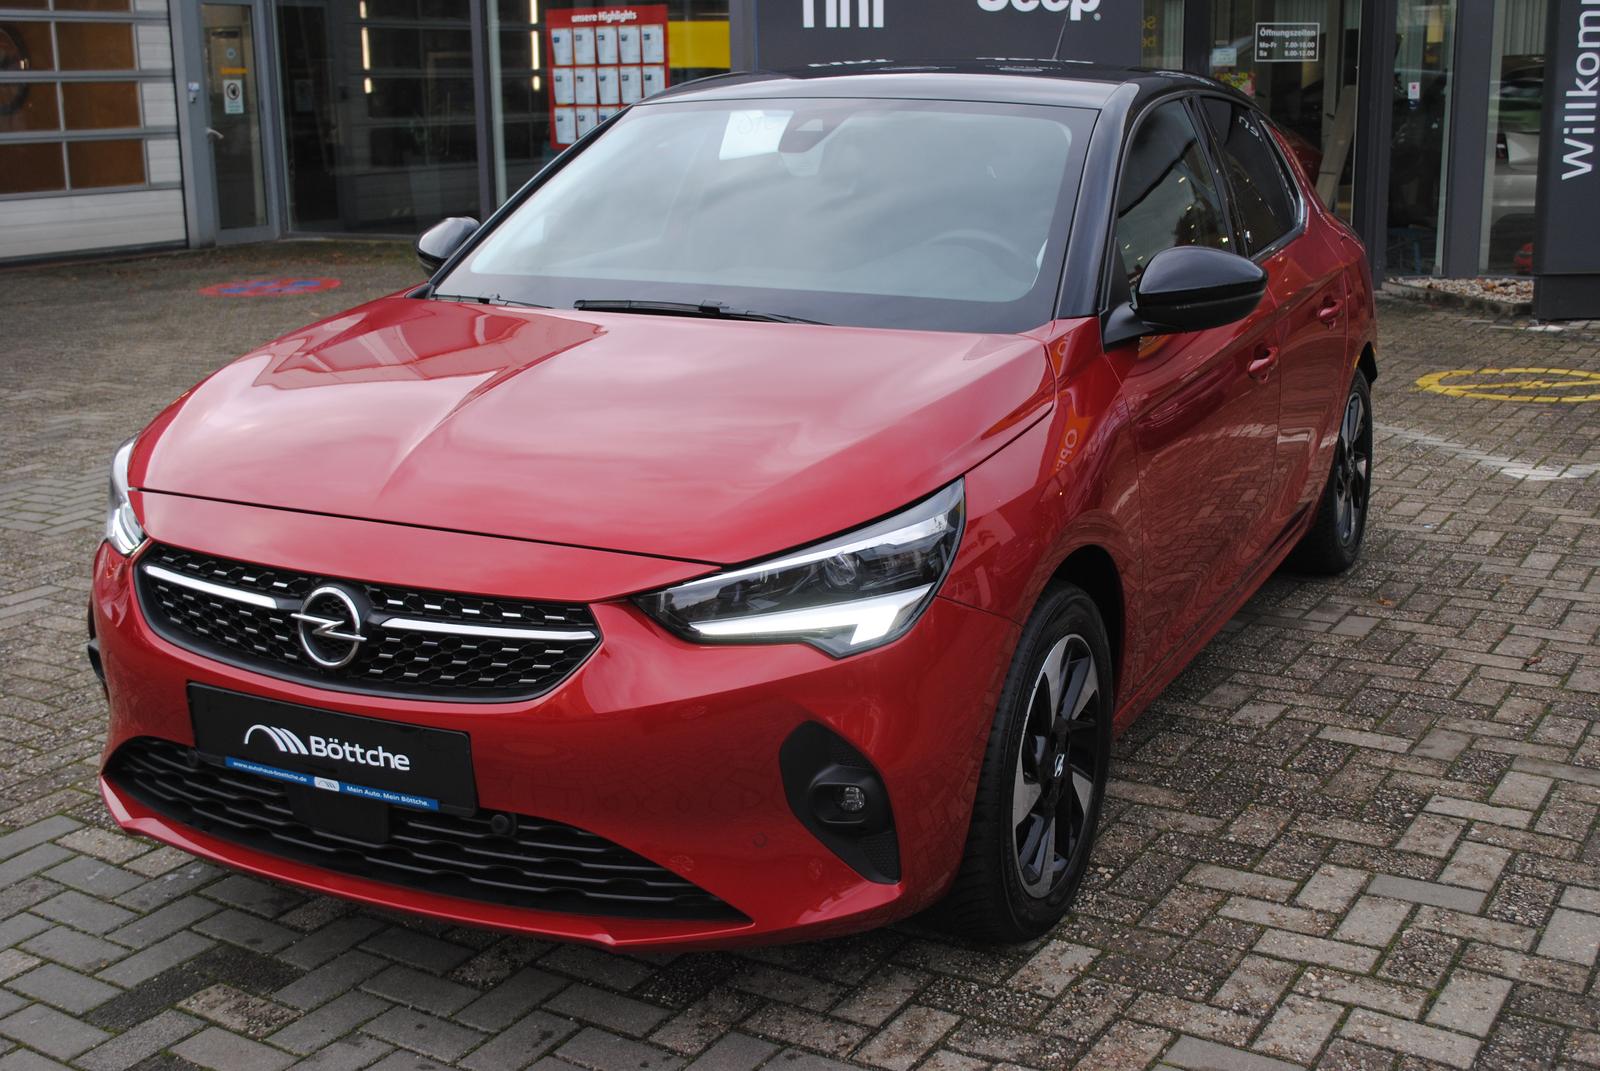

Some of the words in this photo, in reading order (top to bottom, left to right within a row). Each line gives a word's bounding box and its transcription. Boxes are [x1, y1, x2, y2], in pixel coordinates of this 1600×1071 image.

[598, 9, 637, 23] Highlights
[1259, 27, 1316, 38] Öffnungszeiten
[1561, 0, 1600, 182] Willkom
[309, 735, 410, 771] Böttche
[346, 785, 363, 794] Mein
[364, 789, 383, 798] Auto.
[383, 792, 400, 801] Mein
[401, 795, 430, 807] Böttche.
